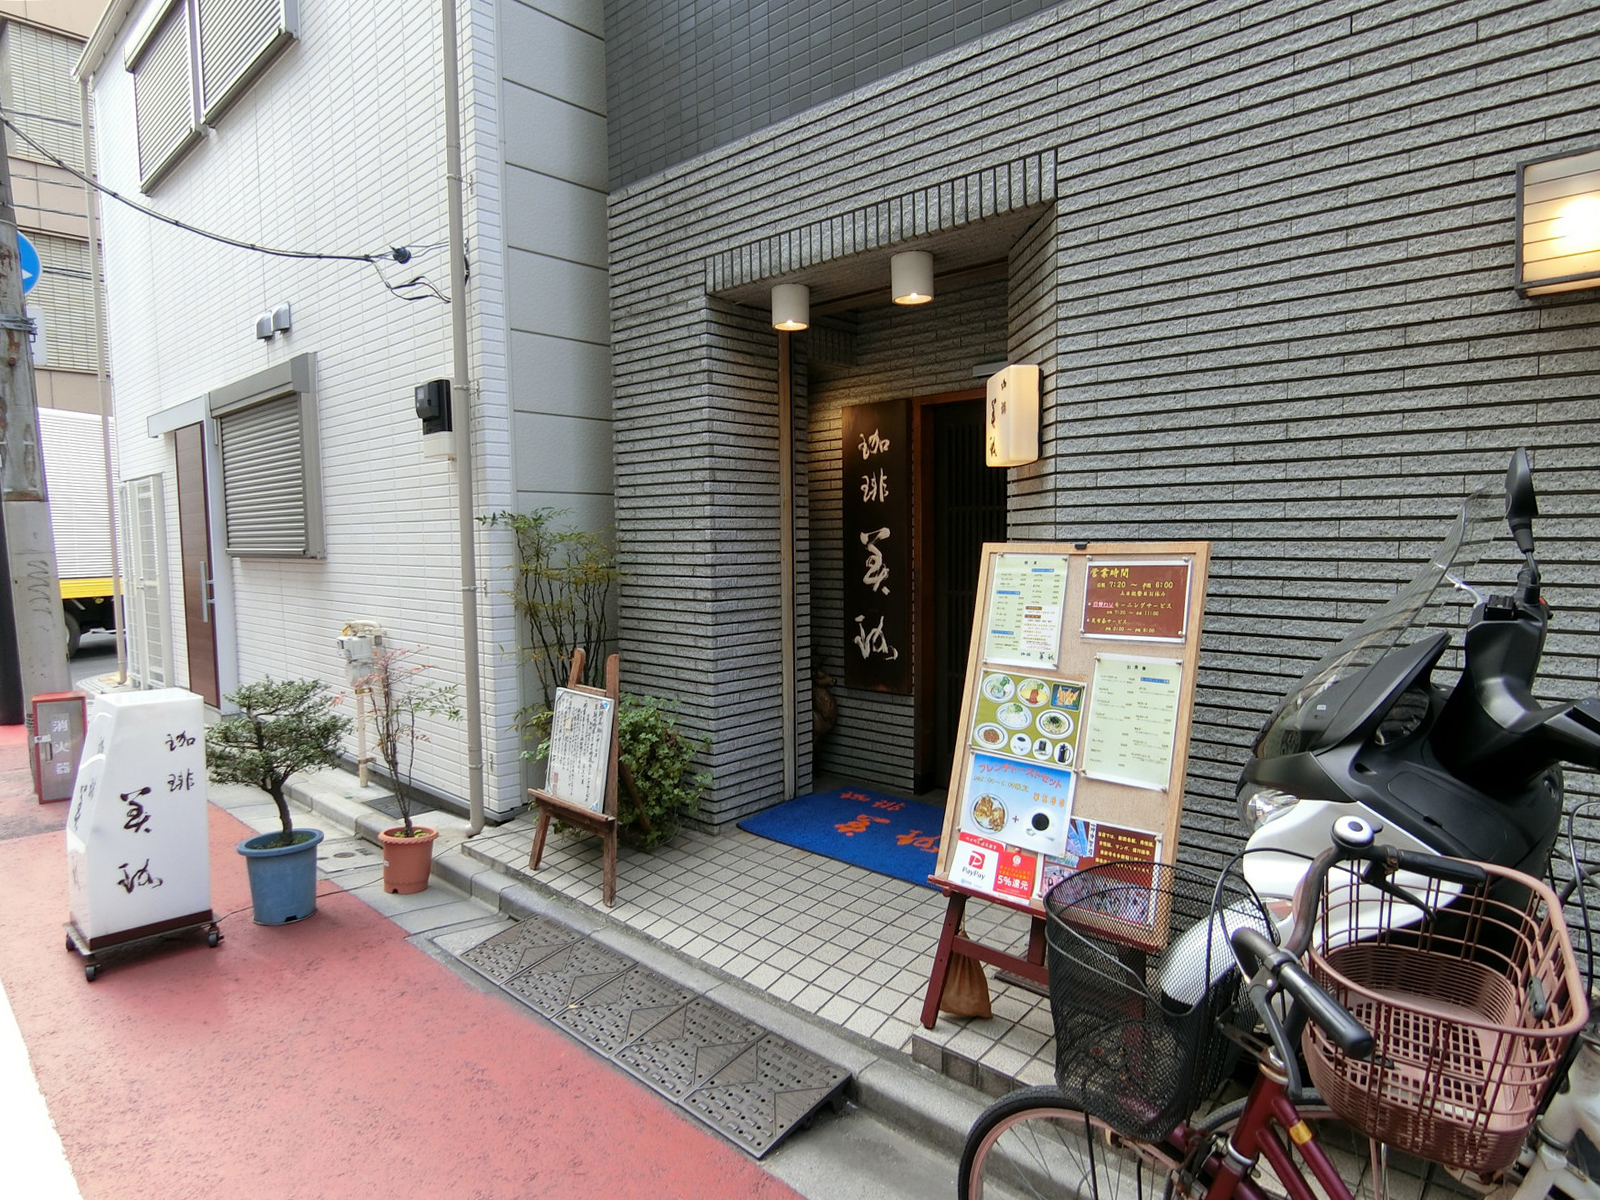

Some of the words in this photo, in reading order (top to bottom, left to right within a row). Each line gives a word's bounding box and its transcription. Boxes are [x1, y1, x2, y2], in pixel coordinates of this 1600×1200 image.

[858, 428, 890, 502] 珈琲
[1090, 567, 1130, 579] 営業時間
[52, 719, 71, 775] 消火器
[164, 730, 196, 792] 珈琲
[978, 763, 1062, 789] フレンチトーストセット
[961, 866, 986, 880] PayPay
[997, 874, 1029, 891] 5%還元
